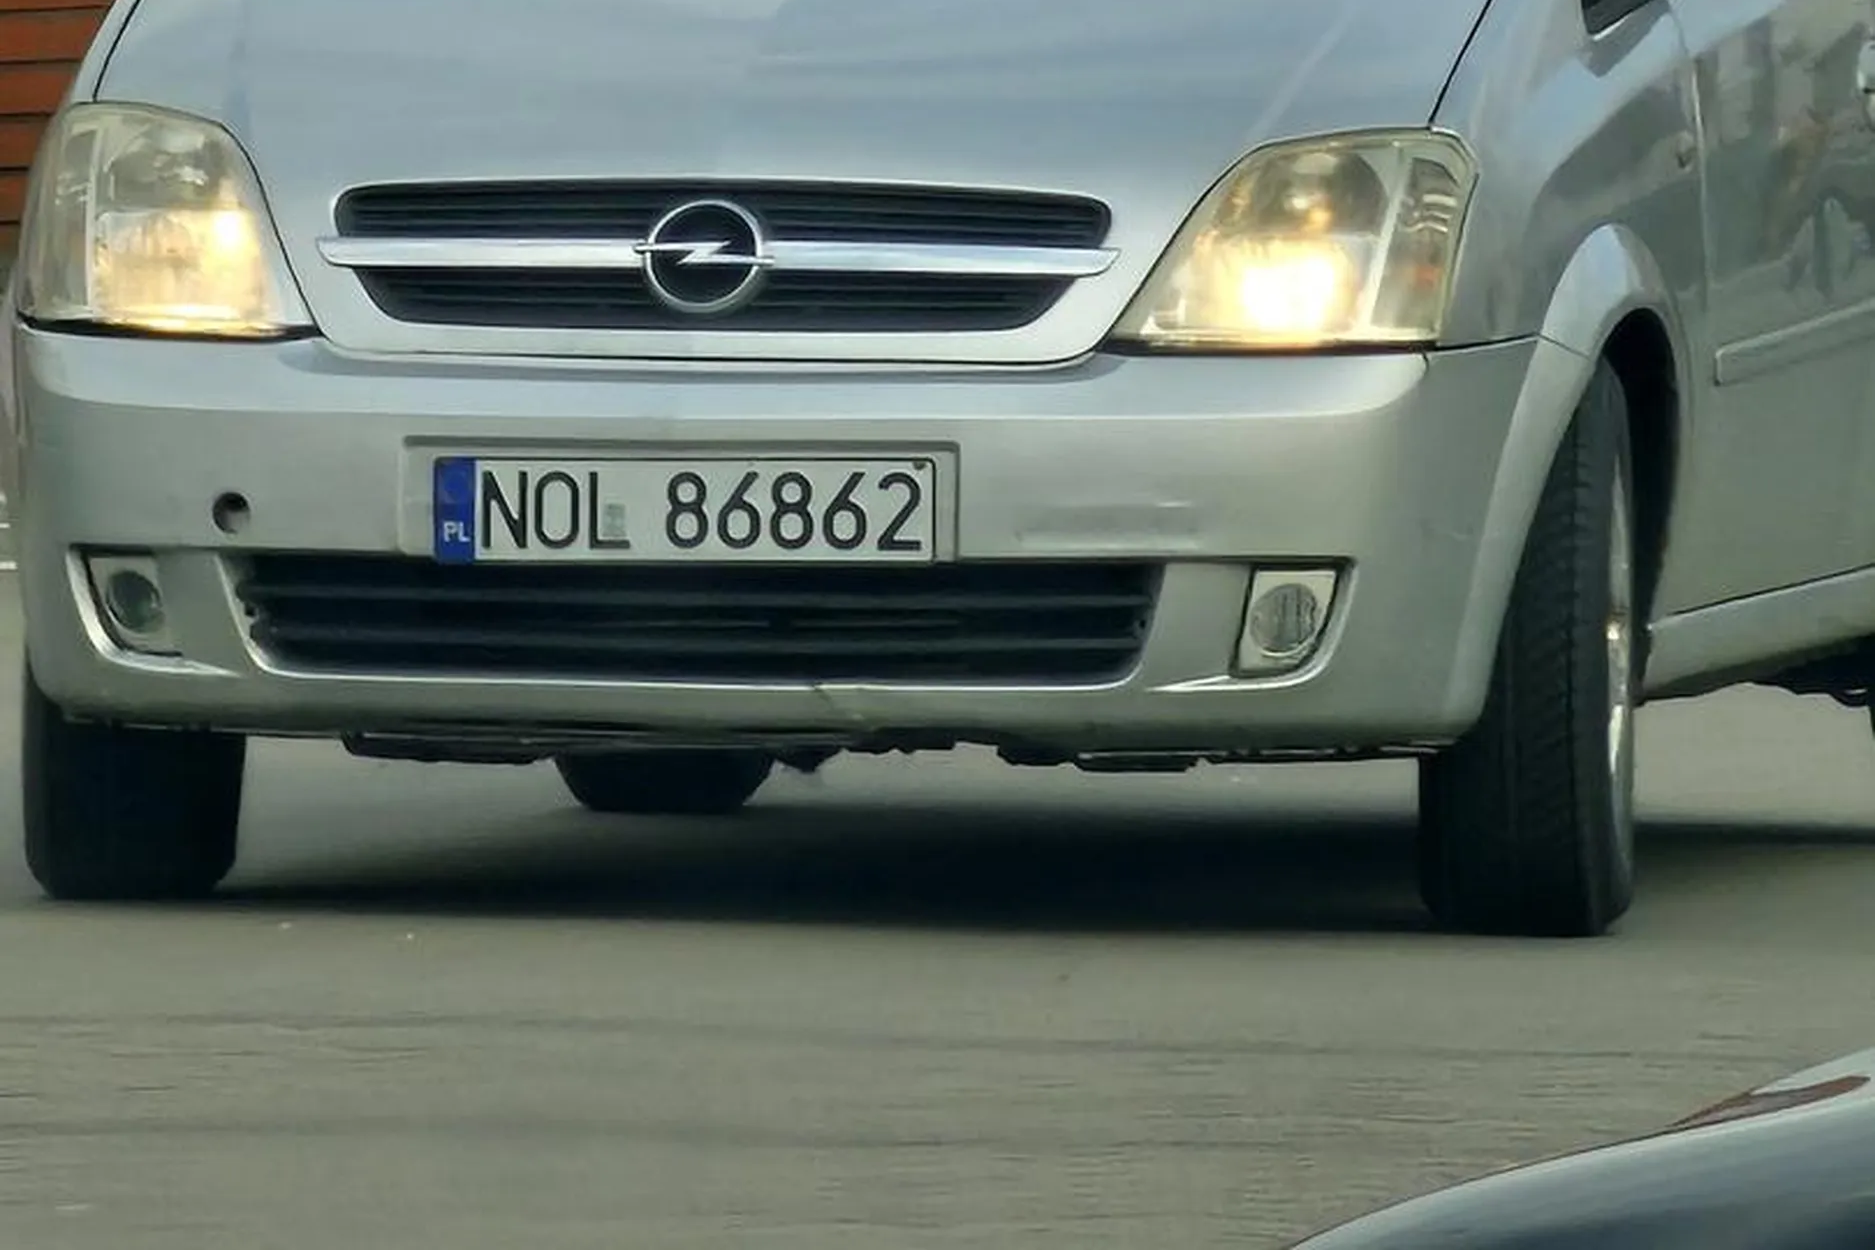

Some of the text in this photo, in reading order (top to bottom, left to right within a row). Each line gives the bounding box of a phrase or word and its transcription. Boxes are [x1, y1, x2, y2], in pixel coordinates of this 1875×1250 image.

[442, 520, 471, 543] PL
[481, 470, 922, 550] NOL 86862
